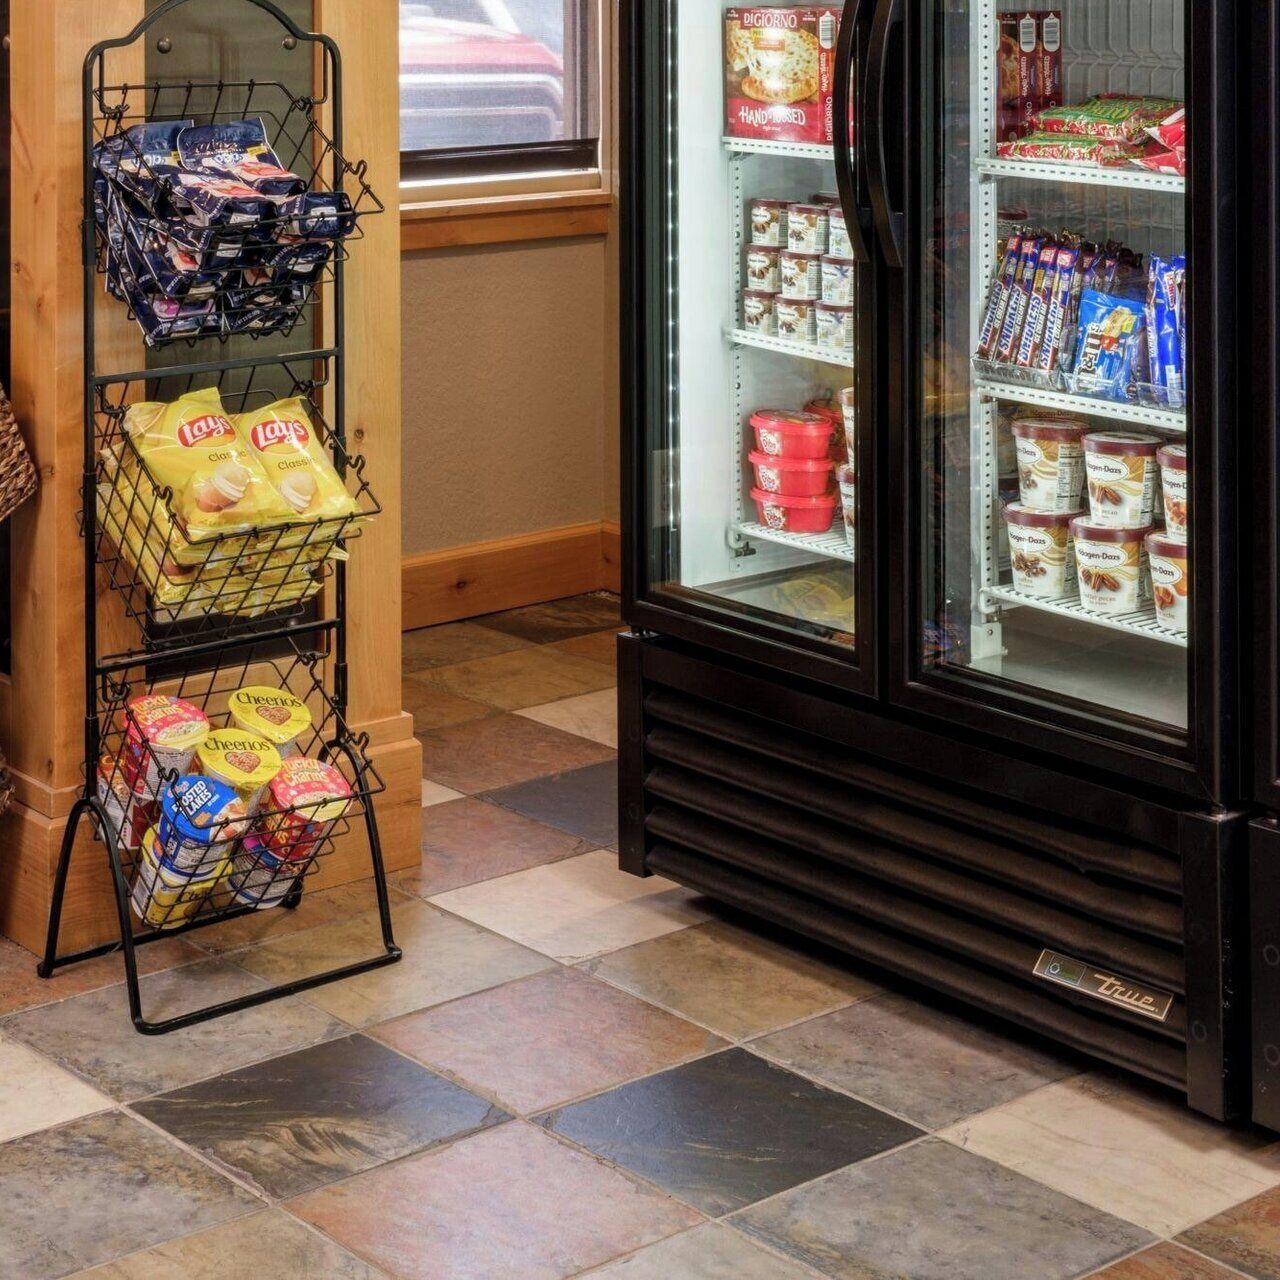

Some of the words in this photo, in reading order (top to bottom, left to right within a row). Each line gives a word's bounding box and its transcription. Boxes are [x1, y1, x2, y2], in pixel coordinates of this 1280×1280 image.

[999, 285, 1021, 351] SNICKERS
[1020, 294, 1042, 361] SNICKERS
[1040, 299, 1057, 368] SNICKERS
[236, 692, 302, 708] Cheerios
[204, 736, 270, 752] Cheerios
[1094, 973, 1155, 1012] true
